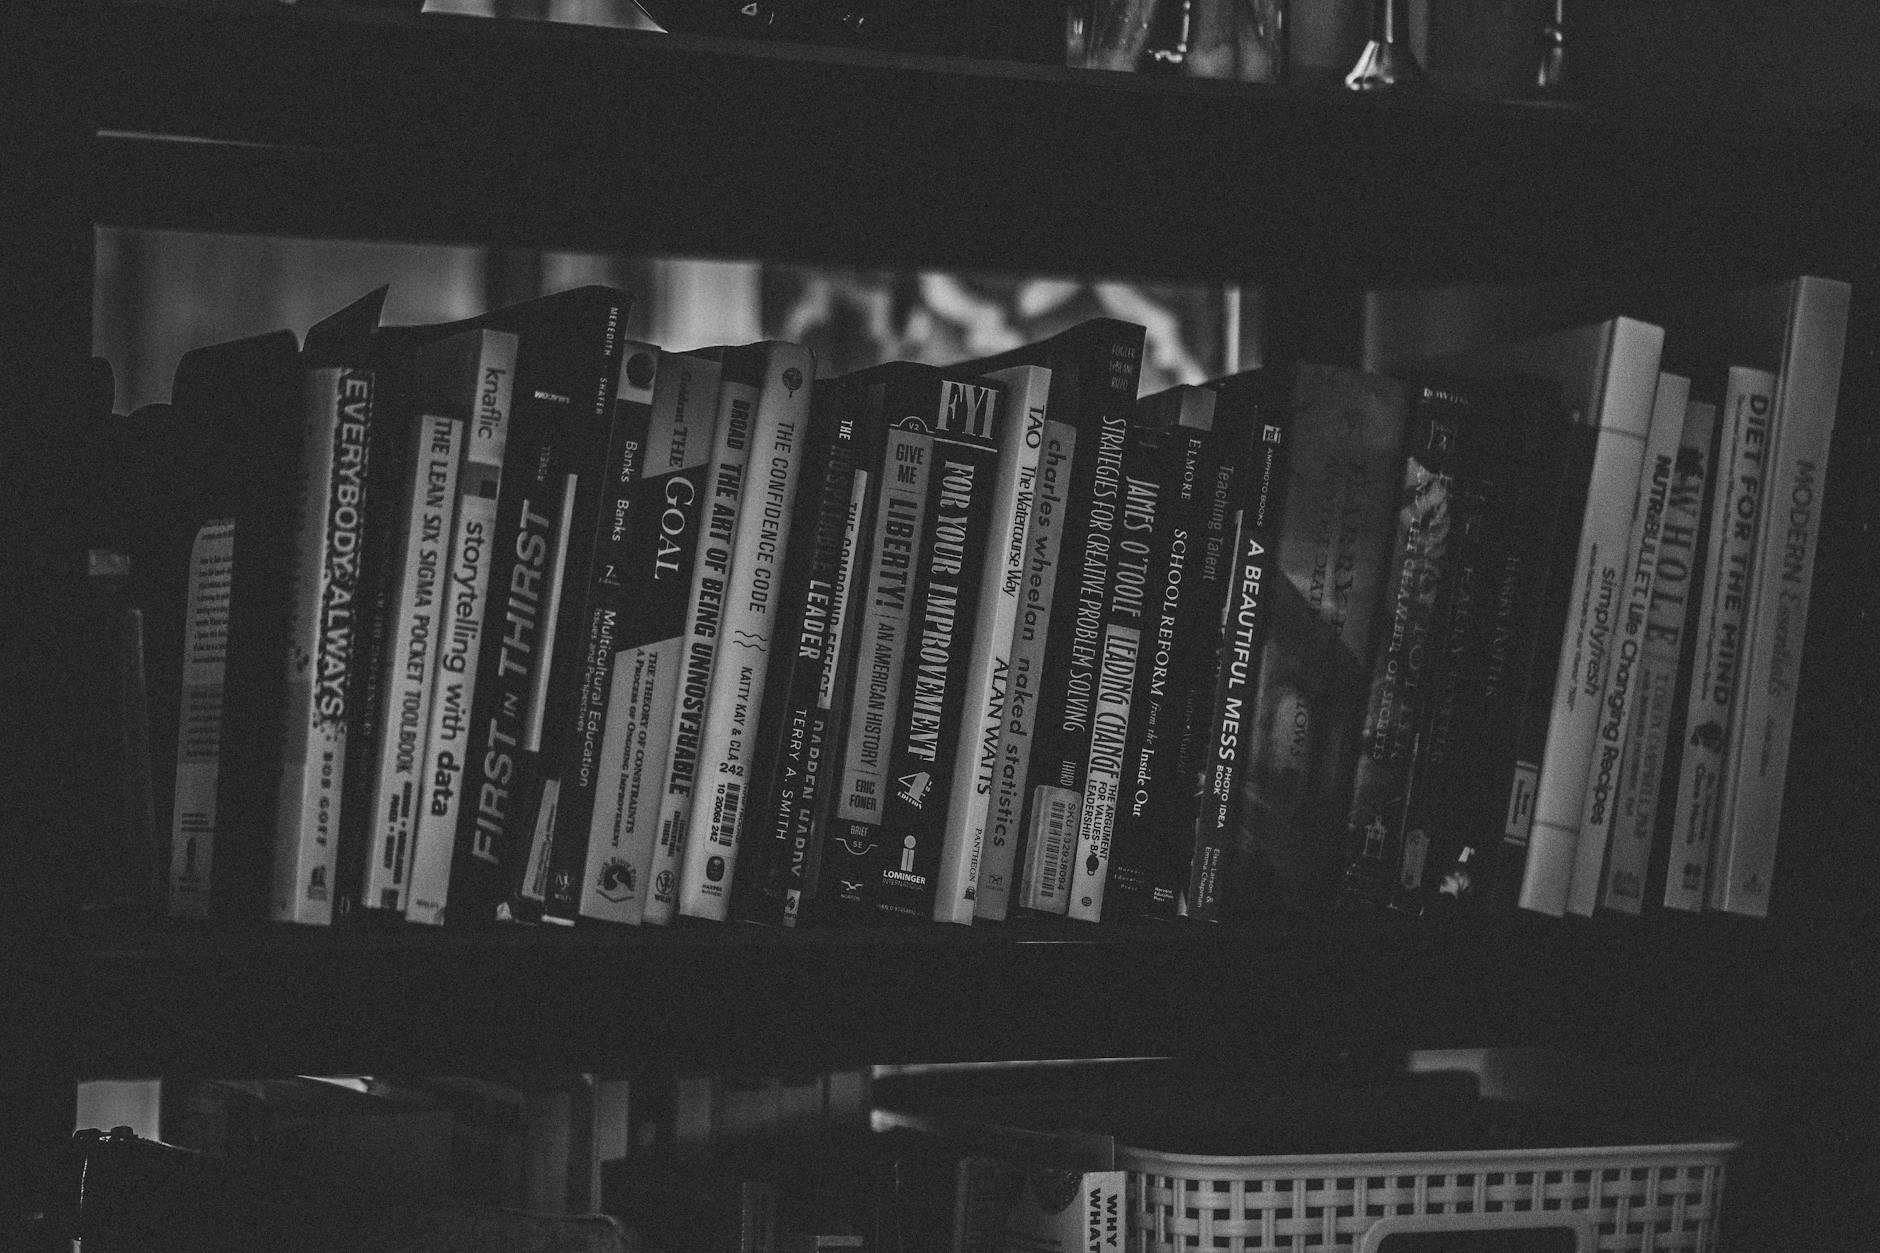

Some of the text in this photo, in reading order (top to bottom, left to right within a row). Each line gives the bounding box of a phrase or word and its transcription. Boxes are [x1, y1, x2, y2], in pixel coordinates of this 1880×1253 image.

[594, 306, 618, 415] MEREDITH SHAFER
[431, 419, 452, 454] THE
[477, 367, 507, 440] knaflic
[726, 399, 750, 450] BROAD
[934, 378, 999, 440] FYI
[1742, 394, 1768, 464] DIET
[667, 425, 687, 468] THE
[895, 443, 924, 464] GIVE
[896, 464, 918, 484] ME
[1091, 415, 1127, 499] STRATEGIES
[1178, 437, 1201, 501] ELMORE
[424, 459, 448, 510] LEAN
[610, 439, 638, 543] Banks Banks
[716, 461, 742, 500] THE
[1001, 404, 1045, 597] TAO The Watercourse Way
[1255, 447, 1273, 526] AMPHOTO BOOKS
[1733, 475, 1757, 540] FOR
[318, 378, 368, 716] EVERYBODY ALWAYS
[421, 513, 441, 544] SIX
[709, 501, 735, 545] ART
[748, 420, 794, 614] THE CONFIDENCE CODE
[797, 418, 854, 661] THE HOSPITABLE LEADER
[1021, 439, 1067, 642] charles wheelan
[1087, 499, 1115, 531] FOR
[1109, 475, 1161, 618] JAMES O'TOOLE
[1201, 463, 1234, 582] Teaching Talent
[1779, 459, 1817, 584] MODERN
[413, 549, 437, 609] SIGMA
[703, 547, 728, 575] OF
[875, 497, 917, 609] LIBERTY!
[1078, 531, 1111, 597] CREATIVE
[1643, 480, 1700, 647] WHOLE
[1723, 554, 1747, 611] THE
[694, 577, 723, 638] BEING
[904, 459, 975, 763] FOR YOUR IMPROVEMENT
[1069, 597, 1102, 668] PROBLEM
[1579, 565, 1618, 697] simplyfresh
[1624, 601, 1645, 636] Life
[404, 613, 430, 684] POCKET
[431, 520, 491, 817] storytelling with data
[586, 642, 598, 663] and
[590, 608, 616, 706] Multicultural
[636, 648, 645, 659] A
[1130, 527, 1188, 818] SCHOOL REFORM from the Inside Out
[1217, 538, 1265, 762] A BEAUTIFUL MESS
[1711, 622, 1738, 705] MIND
[1766, 589, 1803, 698] Essentials
[470, 498, 551, 864] FIRST IN THIRST
[733, 703, 746, 725] KAY
[737, 666, 752, 701] KATTY
[860, 622, 894, 767] AN AMERICAN HISTORY
[1061, 668, 1093, 733] SOLVING
[1088, 634, 1138, 780] LEADING CHANGE
[1601, 638, 1638, 742] Changing
[394, 689, 422, 775] TOOLBOOK
[577, 709, 601, 787] Education
[624, 651, 658, 834] THE THEORY OF CONSTRAINTS
[731, 728, 742, 737] &
[976, 656, 1010, 795] ALAN WATTS
[992, 657, 1037, 848] naked statistics
[718, 761, 744, 777] 242
[773, 707, 807, 840] TERRY A. SMITH
[848, 793, 877, 810] FONER
[854, 779, 875, 794] ERIC
[1059, 759, 1077, 787] THIRD
[1096, 780, 1107, 801] FOR
[1212, 764, 1224, 795] BOOK
[1215, 765, 1232, 829] PHOTO IDEA
[1586, 744, 1619, 826] Recipes
[709, 783, 726, 842] 10 20068 242
[1065, 802, 1076, 827] SKU
[1080, 778, 1097, 840] LEADERSHIP
[1098, 783, 1116, 860] THE ARGUMENT
[882, 869, 926, 884] LOMINGER
[966, 827, 982, 882] PANTHEON
[1089, 1187, 1101, 1253] WHAT
[1106, 1194, 1118, 1247] WHY
